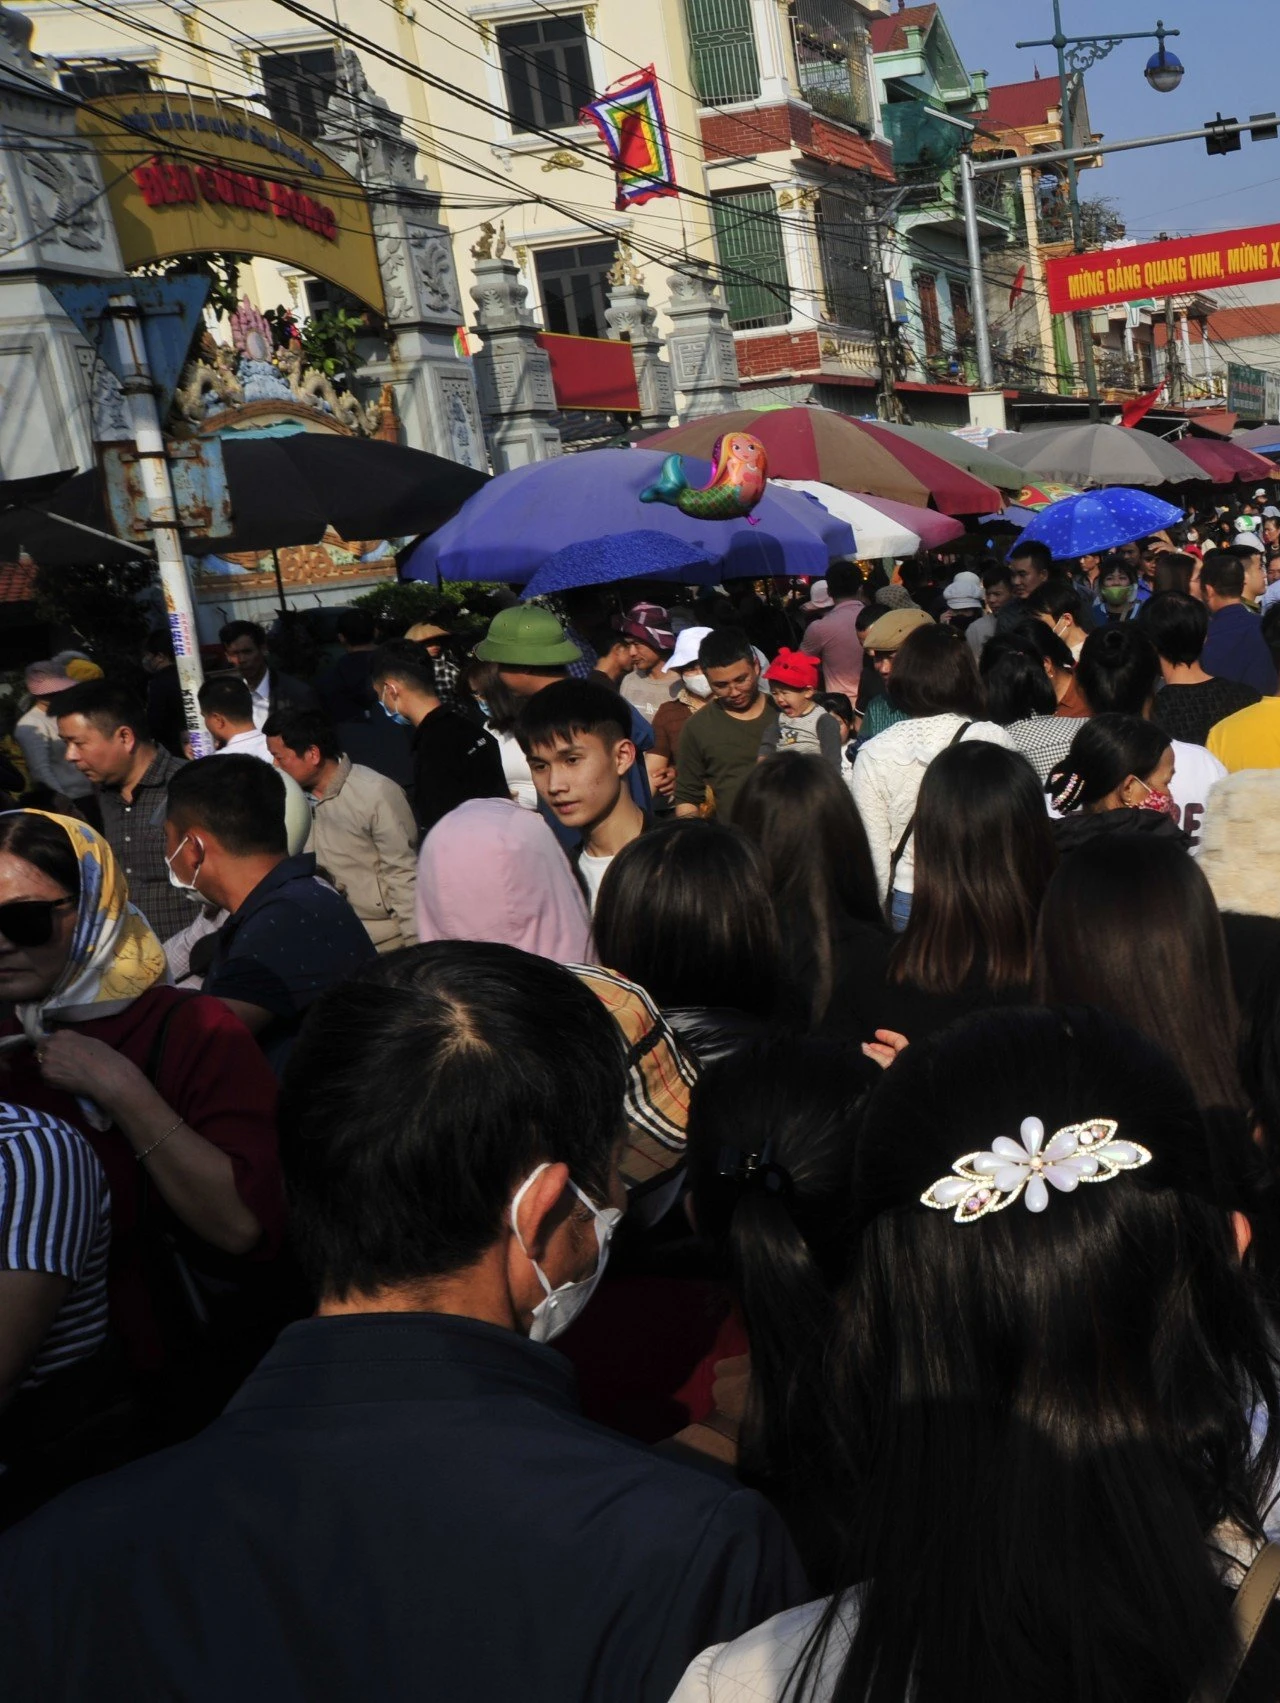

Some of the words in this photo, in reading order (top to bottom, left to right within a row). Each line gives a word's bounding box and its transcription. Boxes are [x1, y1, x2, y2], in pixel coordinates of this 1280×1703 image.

[1068, 268, 1105, 300] MỪNG
[1107, 258, 1141, 293] ĐẢNG
[1144, 256, 1187, 290] QUANG
[1189, 251, 1225, 279] VINH,
[1228, 241, 1268, 275] MỪNG
